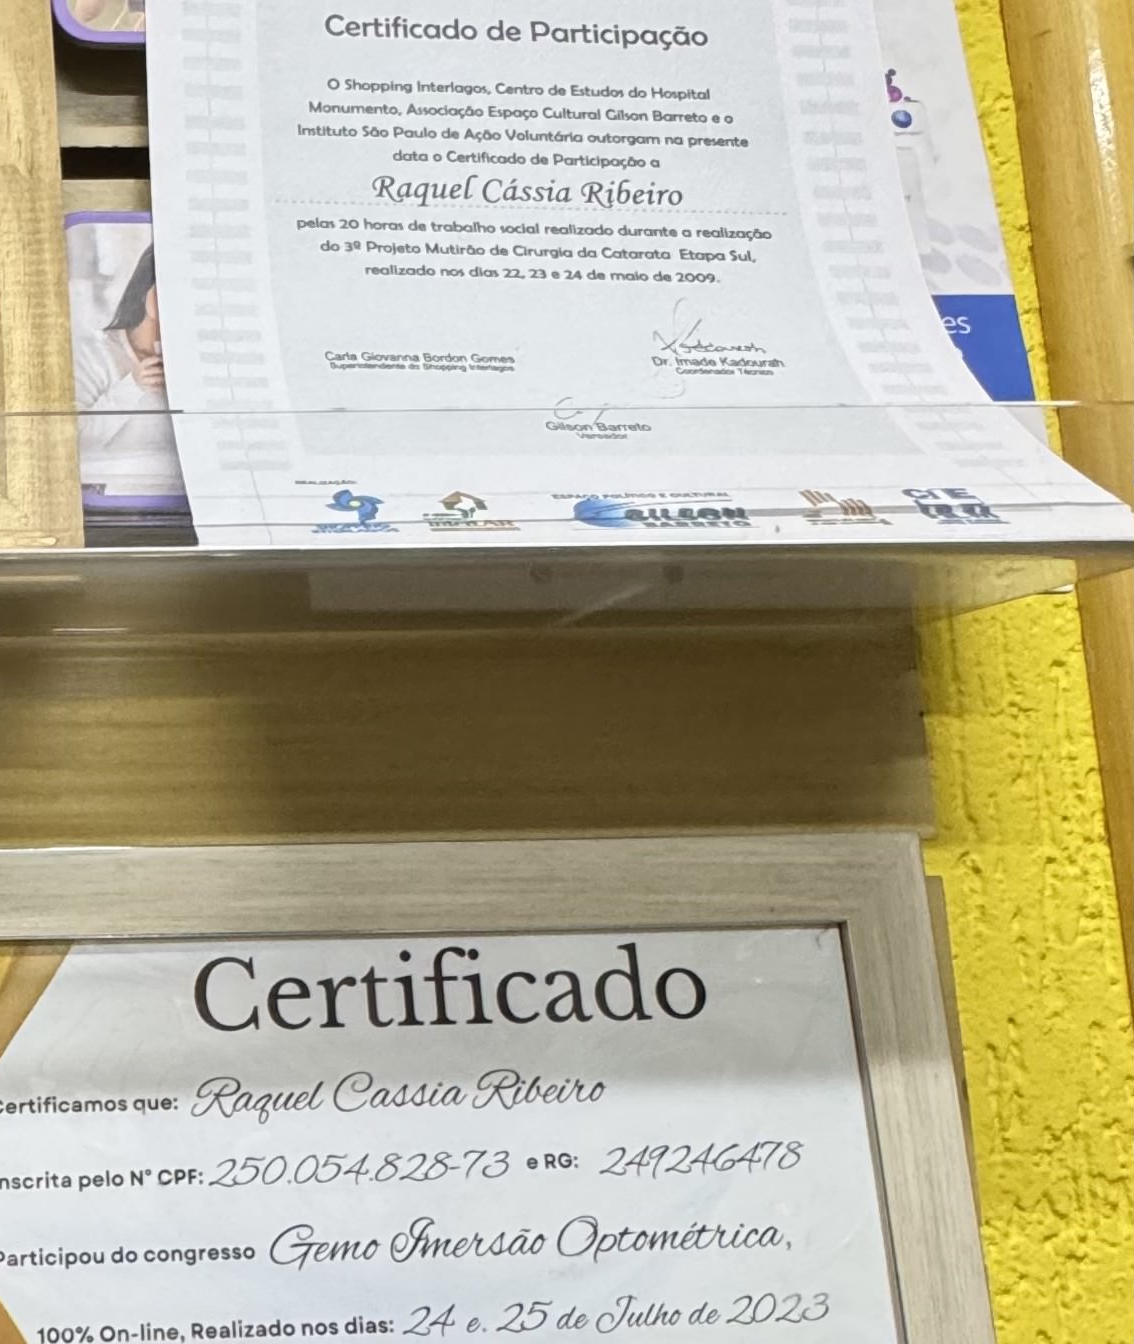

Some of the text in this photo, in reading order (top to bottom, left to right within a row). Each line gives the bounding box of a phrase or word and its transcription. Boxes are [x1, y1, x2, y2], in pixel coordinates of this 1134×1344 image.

[324, 13, 709, 52] Certificado de Participação
[326, 77, 711, 102] O Shopping Interlagos, Centro de Estudos do Hospital
[372, 175, 684, 212] Raquel Cássia Ribeiro
[193, 942, 707, 1032] Certificado
[132, 1097, 179, 1115] que:
[190, 1075, 325, 1123] Raquel
[332, 1069, 468, 1113] Cassia
[472, 1068, 606, 1110] Ribeiro
[78, 1169, 125, 1193] pelo
[157, 1168, 205, 1188] CPF:
[208, 1151, 511, 1188] 250.054.828-73
[526, 1156, 539, 1170] e
[543, 1152, 579, 1170] RG:
[598, 1140, 805, 1180] 249246478
[110, 1245, 138, 1265] do
[143, 1246, 256, 1267] congresso
[269, 1223, 382, 1271] Gemo
[556, 1216, 792, 1264] Optométrica,
[36, 1325, 95, 1344] 100%
[99, 1322, 186, 1344] On-line,
[190, 1318, 296, 1340] Realizado
[300, 1321, 339, 1337] nos
[344, 1315, 395, 1335] dias:
[401, 1303, 456, 1338] 24
[495, 1300, 554, 1334] 25
[556, 1305, 590, 1330] de
[595, 1293, 683, 1335] Julho
[687, 1301, 722, 1326] de
[725, 1292, 830, 1326] 2023
